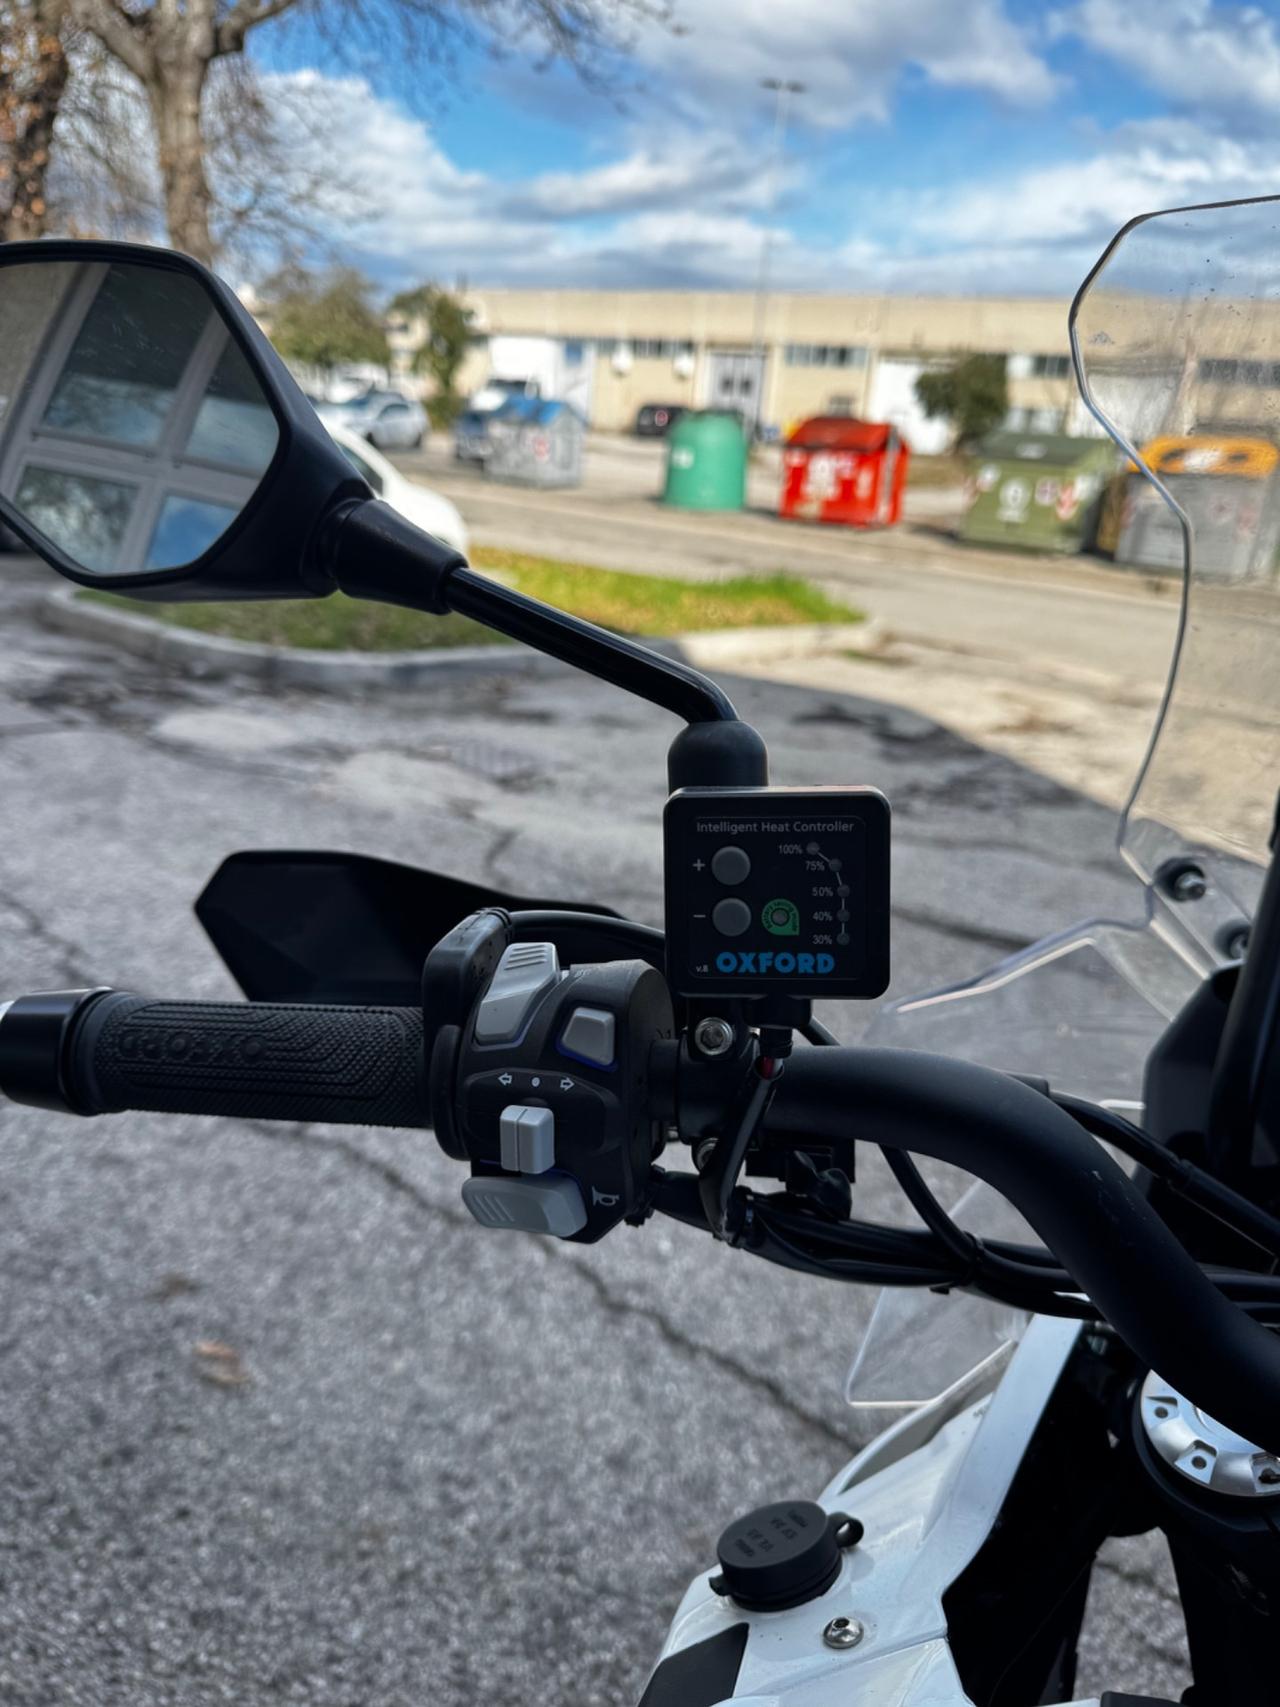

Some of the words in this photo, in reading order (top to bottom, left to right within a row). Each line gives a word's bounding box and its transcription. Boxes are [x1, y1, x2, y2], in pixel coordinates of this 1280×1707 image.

[696, 822, 757, 834] Intelligent
[761, 822, 789, 832] Heat
[793, 821, 854, 832] Controller
[778, 844, 803, 855] 100%
[805, 860, 825, 871] 75%
[812, 887, 834, 897] 50%
[812, 911, 832, 922] 40%
[812, 934, 832, 945] 30%
[715, 951, 836, 974] OXFORD
